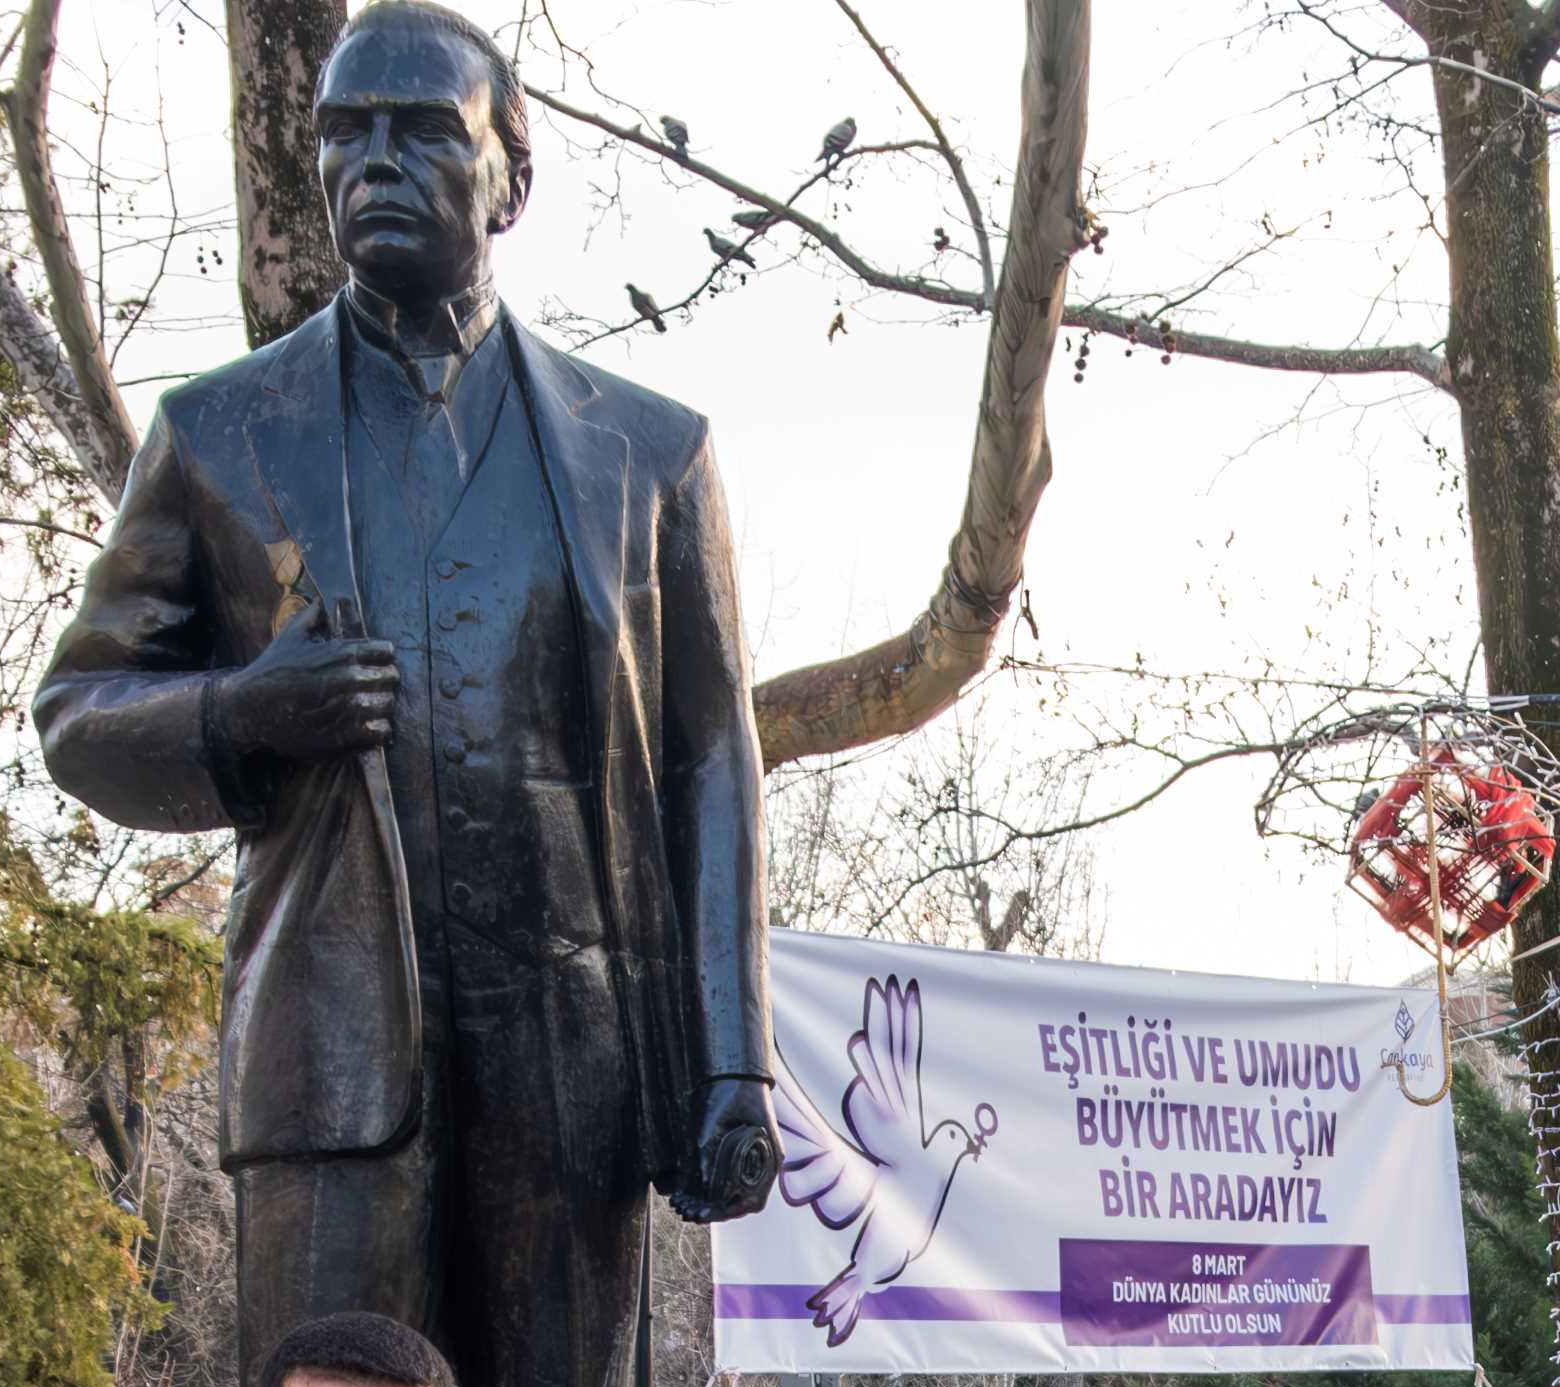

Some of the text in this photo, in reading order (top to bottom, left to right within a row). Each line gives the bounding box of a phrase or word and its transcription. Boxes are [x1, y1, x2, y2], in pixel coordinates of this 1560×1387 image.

[1038, 1011, 1361, 1092] EŞİTLİĞİ VE UMUDU
[1076, 1084, 1337, 1170] BÜYÜTMEK İÇİN
[1099, 1155, 1328, 1223] BİR ARADAYIZ
[1192, 1254, 1246, 1276] 8 MART
[1112, 1276, 1332, 1304] DÜNYA KADINLAR GÜNÜNÜZ
[1168, 1313, 1282, 1334] KUTLU OLSUN
